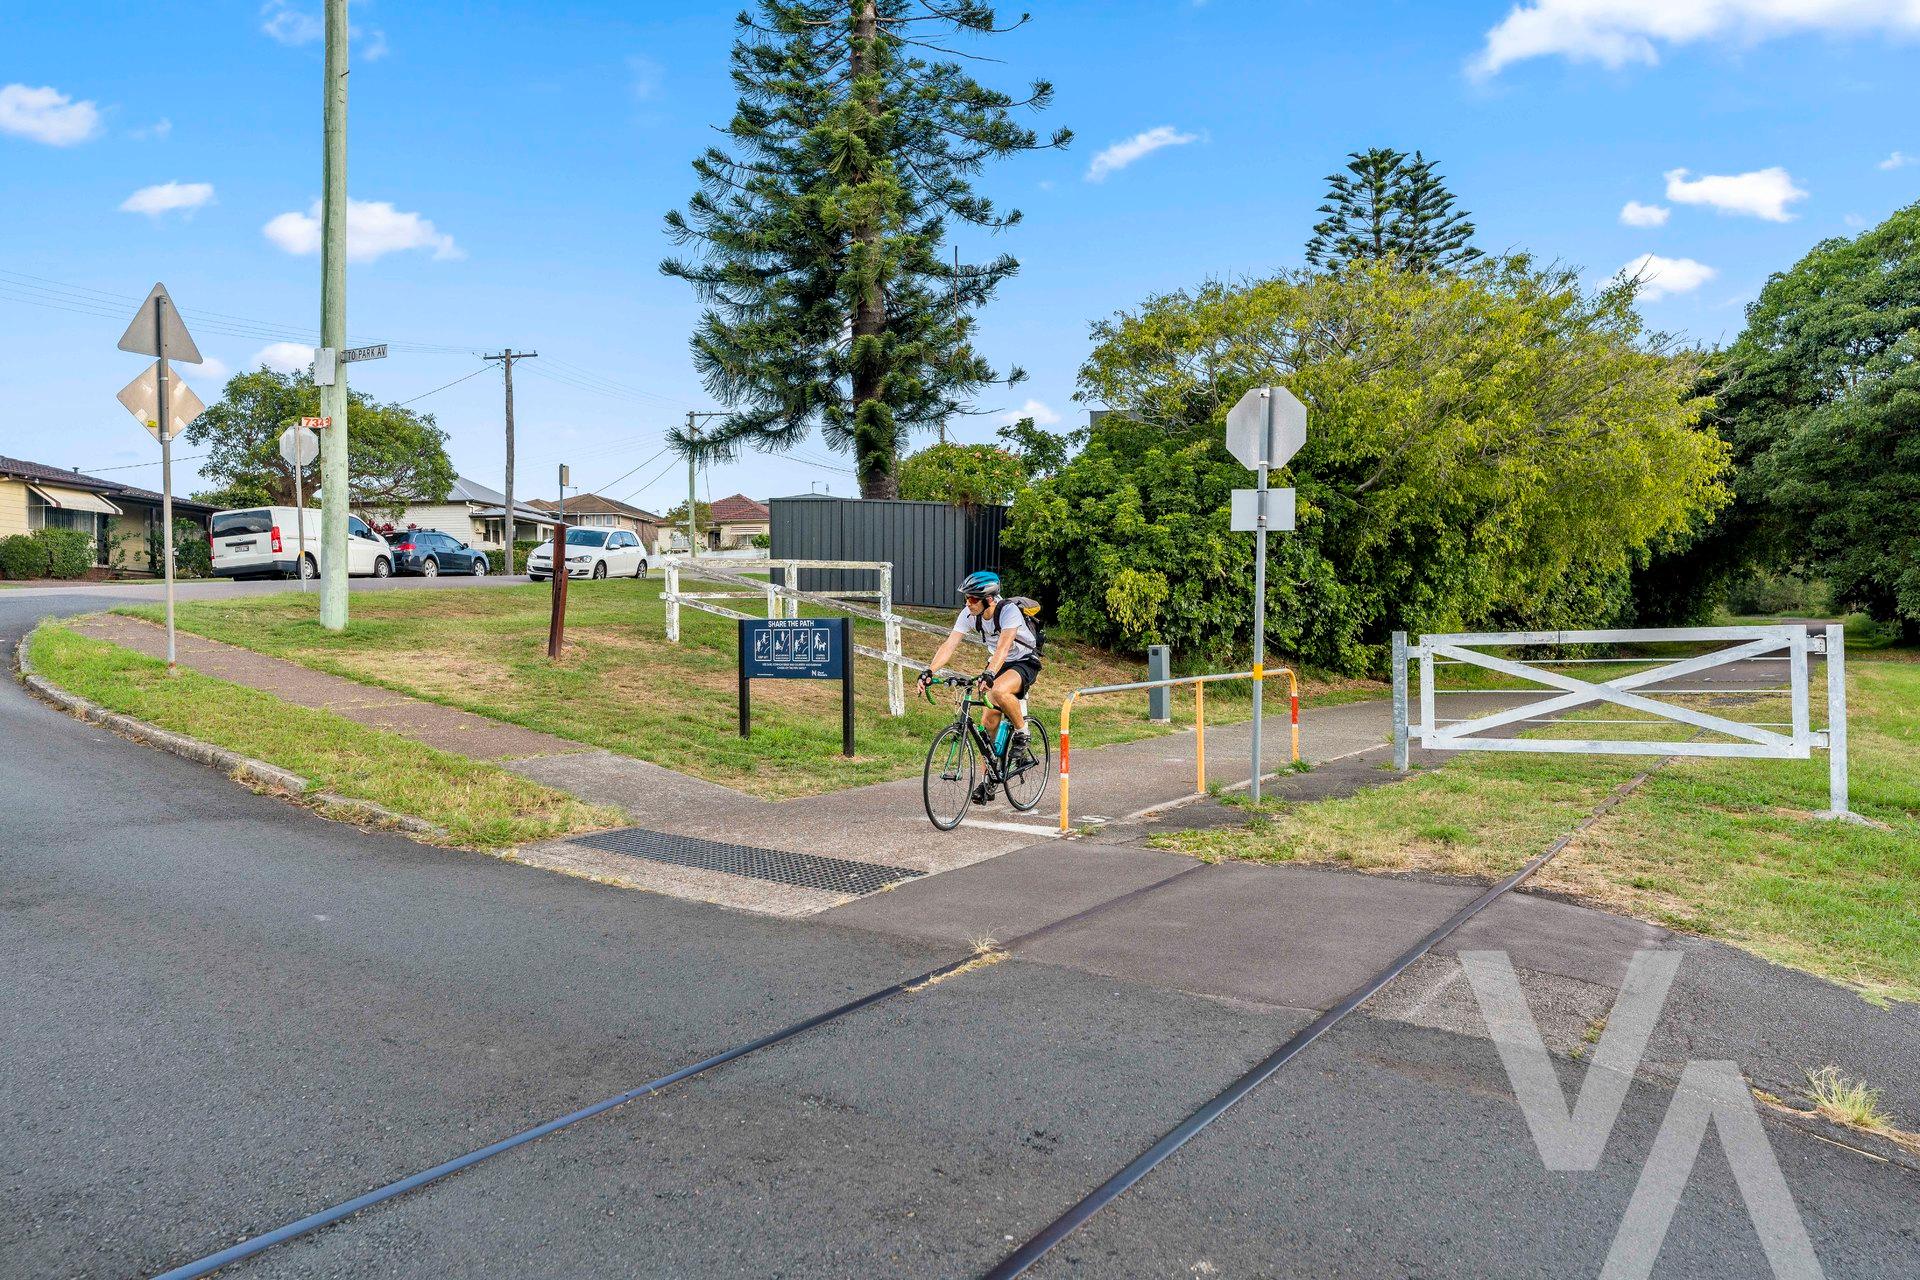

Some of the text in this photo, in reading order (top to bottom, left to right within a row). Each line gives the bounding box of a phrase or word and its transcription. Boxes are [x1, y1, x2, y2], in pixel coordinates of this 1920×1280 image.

[348, 347, 386, 360] TO PARK AV
[767, 620, 787, 628] SHARE
